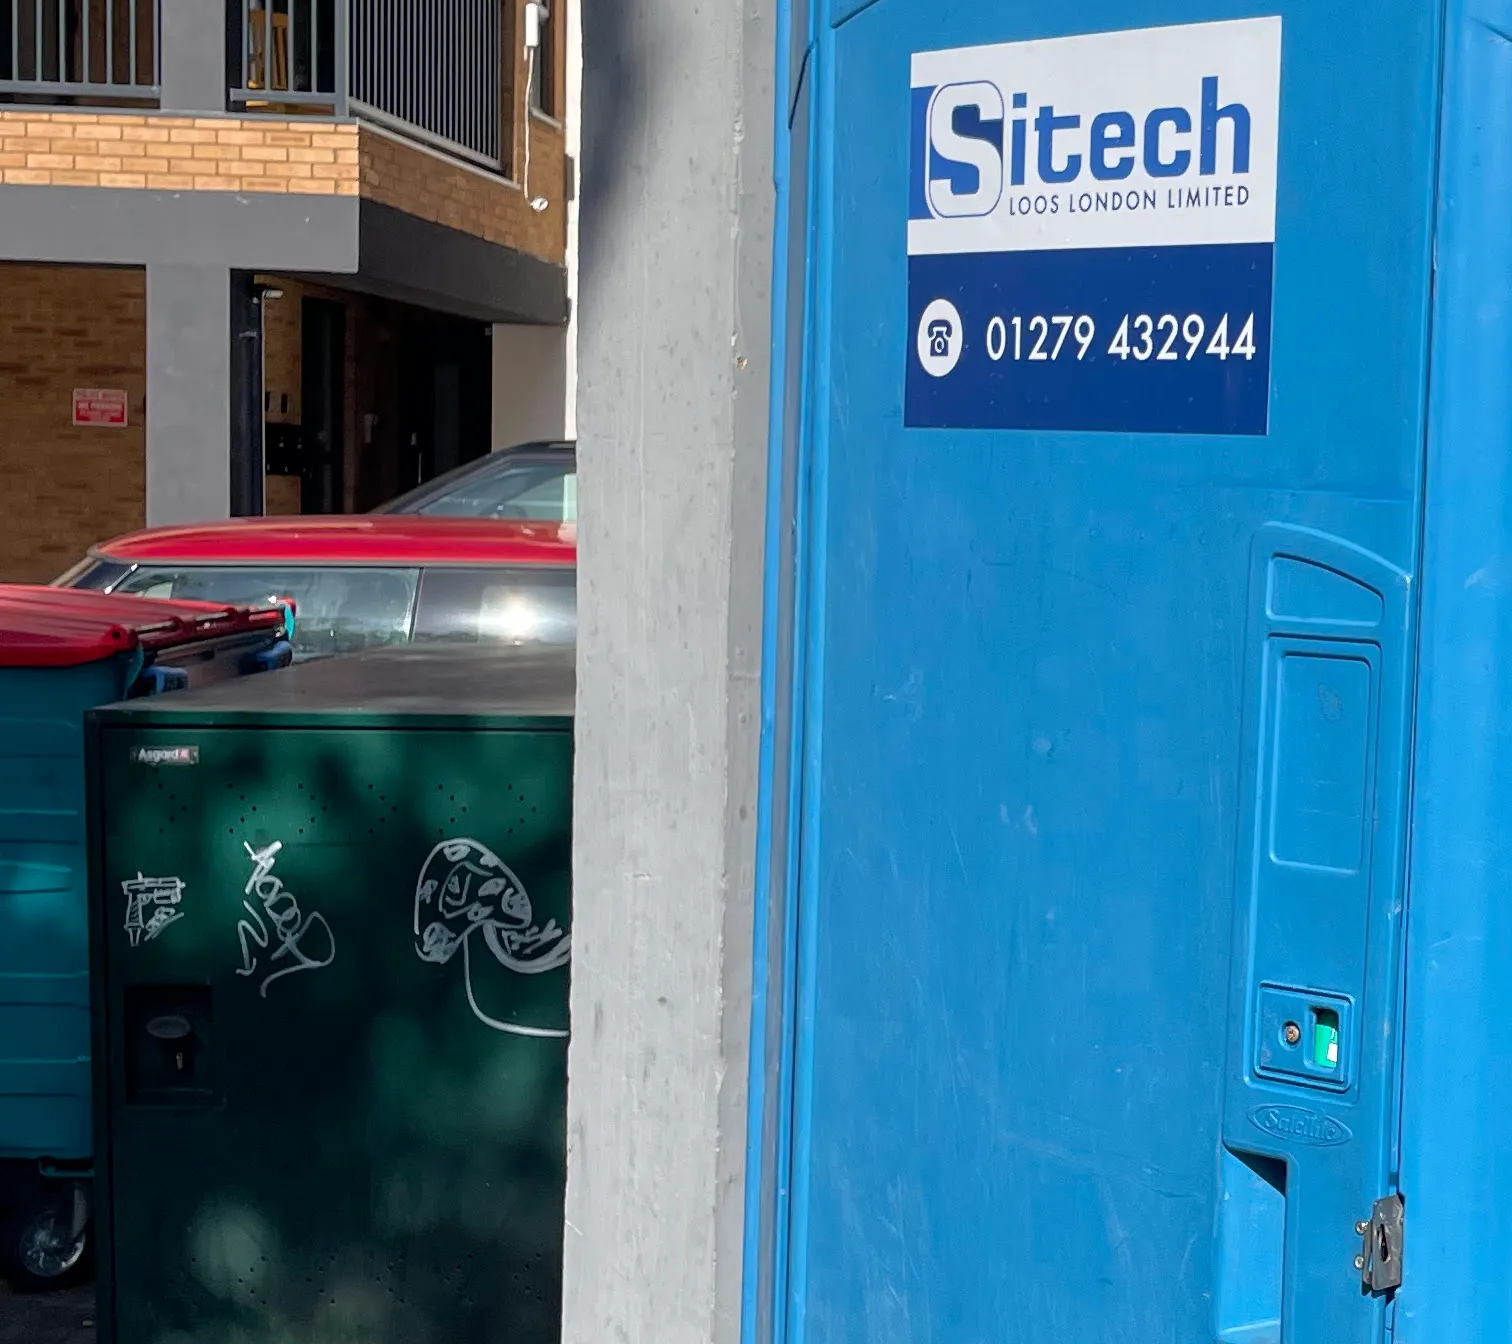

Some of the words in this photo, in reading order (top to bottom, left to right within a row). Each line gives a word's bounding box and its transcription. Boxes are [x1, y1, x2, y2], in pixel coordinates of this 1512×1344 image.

[928, 76, 1251, 218] Sitech
[1009, 194, 1060, 216] LOOS
[1069, 189, 1157, 213] LONDON
[1167, 185, 1250, 210] LIMITED
[985, 314, 1096, 362] 01279
[1107, 312, 1256, 362] 432944
